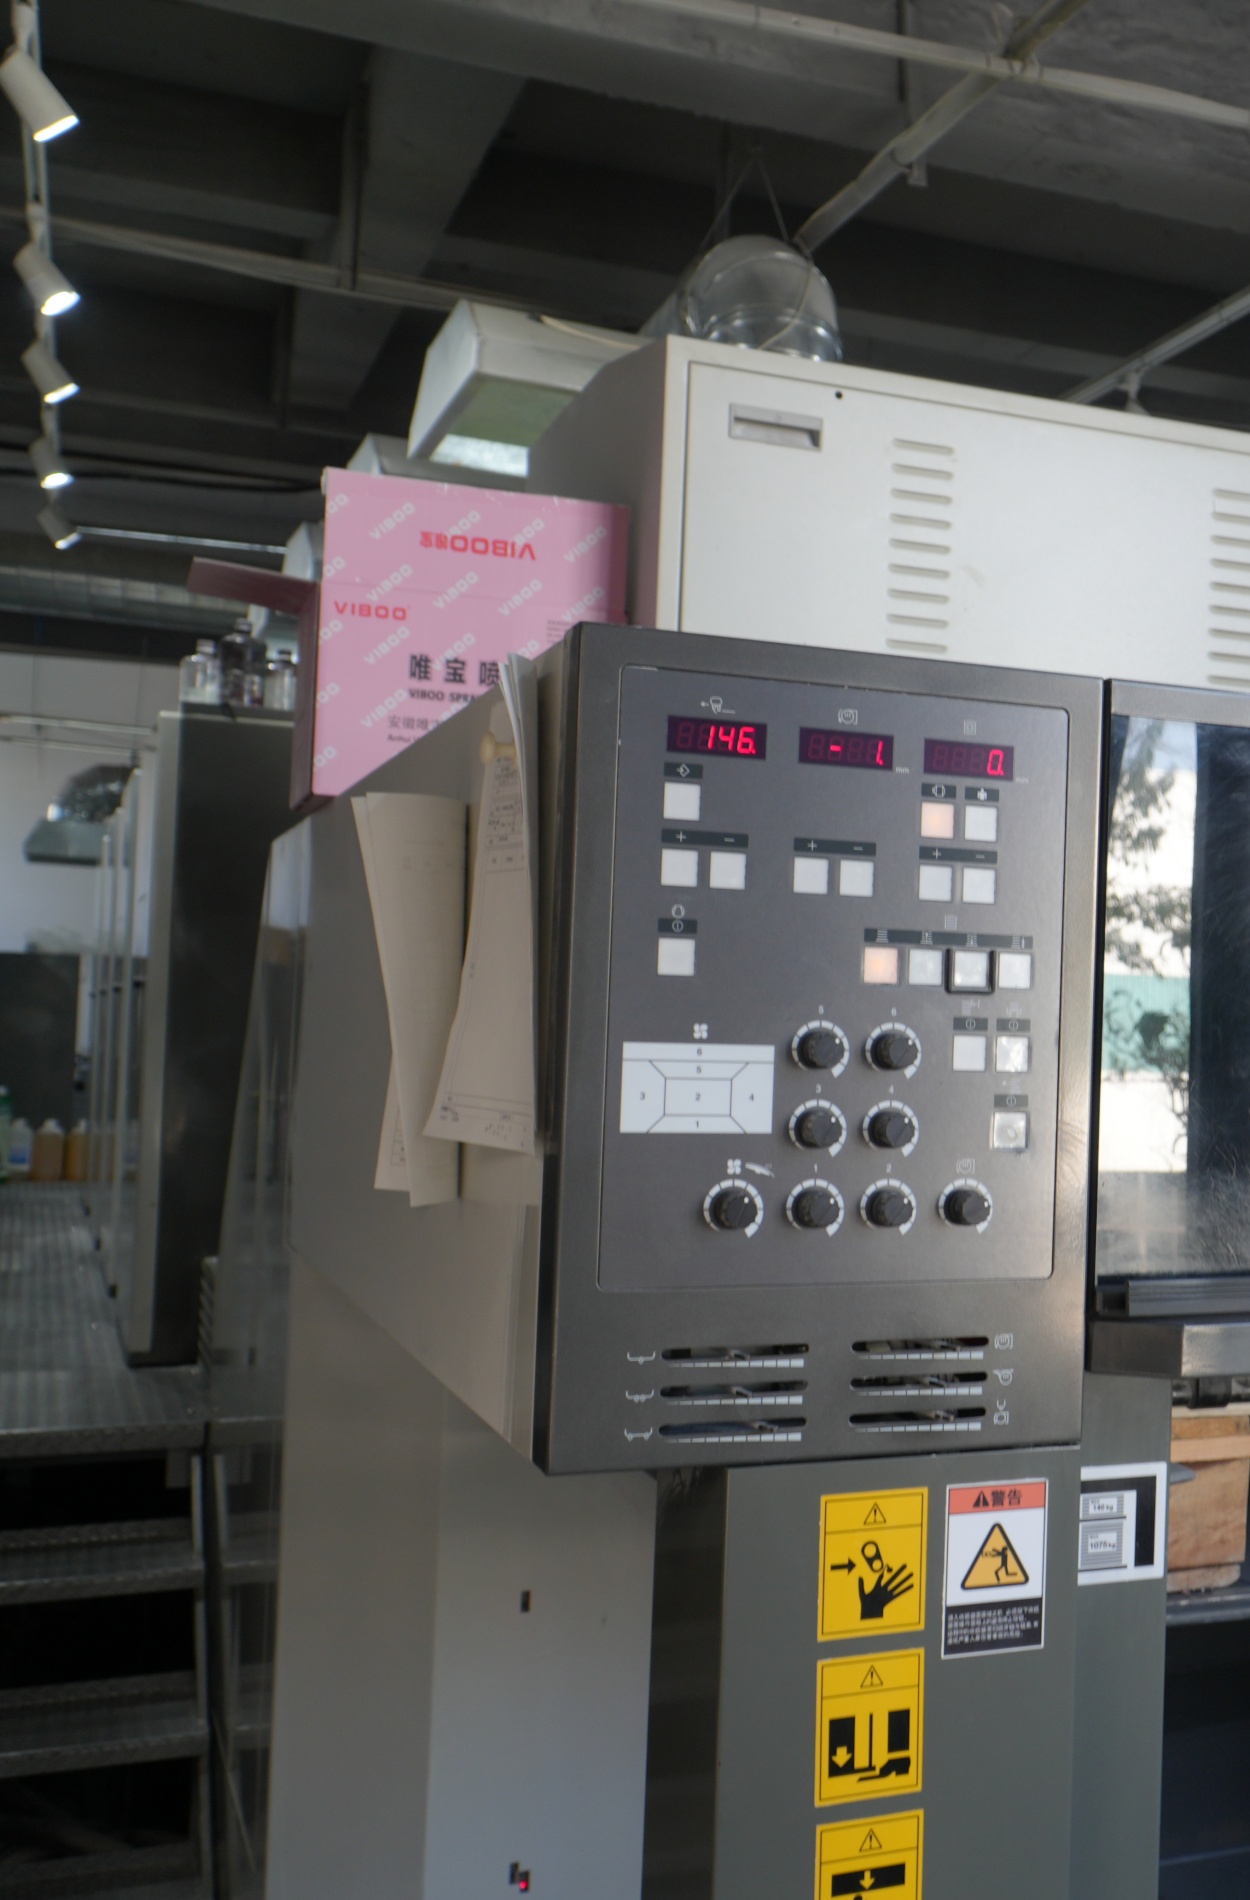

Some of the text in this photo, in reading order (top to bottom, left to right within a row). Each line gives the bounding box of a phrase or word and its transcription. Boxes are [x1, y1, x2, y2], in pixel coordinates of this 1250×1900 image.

[369, 502, 415, 539] VIBOO
[563, 526, 607, 562] VIBOO
[366, 564, 413, 601] VIBOO
[433, 571, 478, 609] VIBOO
[498, 578, 543, 616] VIBOO
[334, 600, 407, 620] VIBOO
[562, 586, 605, 621] VIBOO
[363, 626, 410, 664] VIBOO
[432, 633, 476, 670] VIBOO
[361, 689, 408, 728] VIBOO
[409, 688, 444, 702] VIBOO
[387, 715, 438, 731] 安徽唯
[991, 1488, 1022, 1507] 警告
